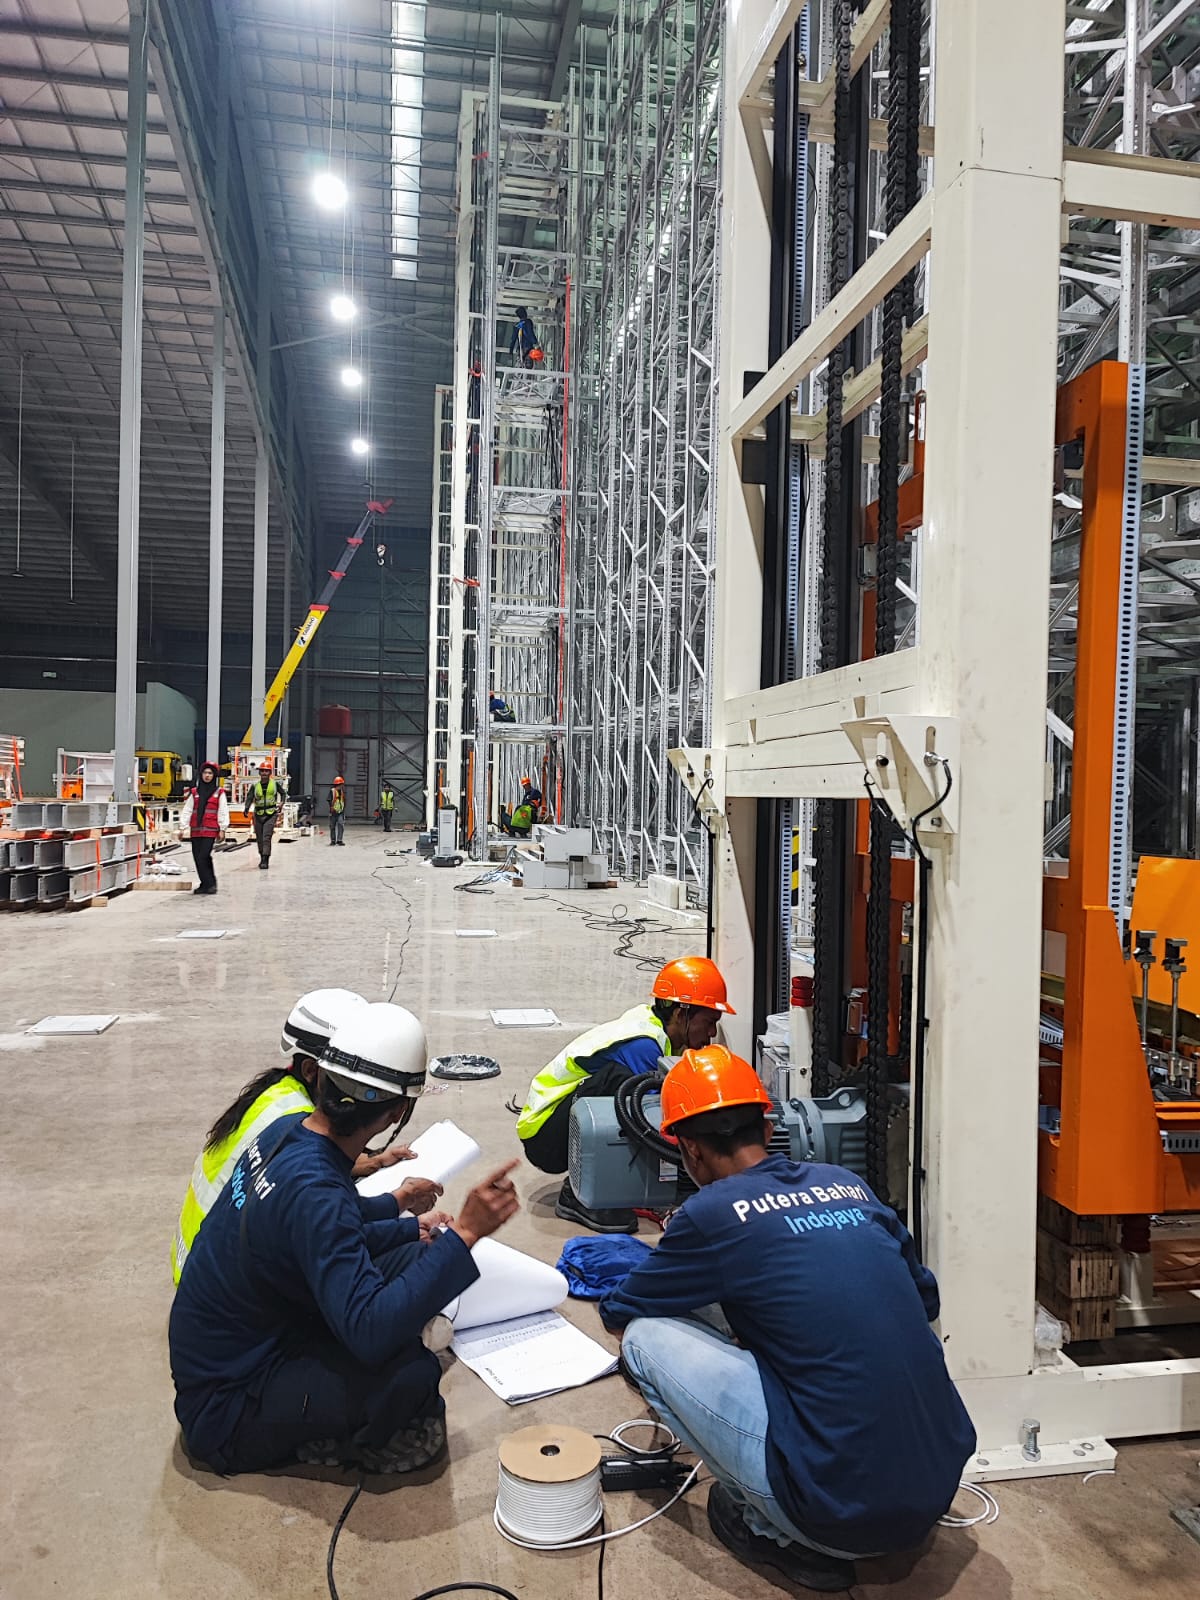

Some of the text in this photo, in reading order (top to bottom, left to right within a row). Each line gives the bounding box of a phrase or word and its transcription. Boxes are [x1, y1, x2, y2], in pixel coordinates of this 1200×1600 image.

[732, 1182, 870, 1223] Putera Bahari
[783, 1207, 867, 1235] Indojaya
